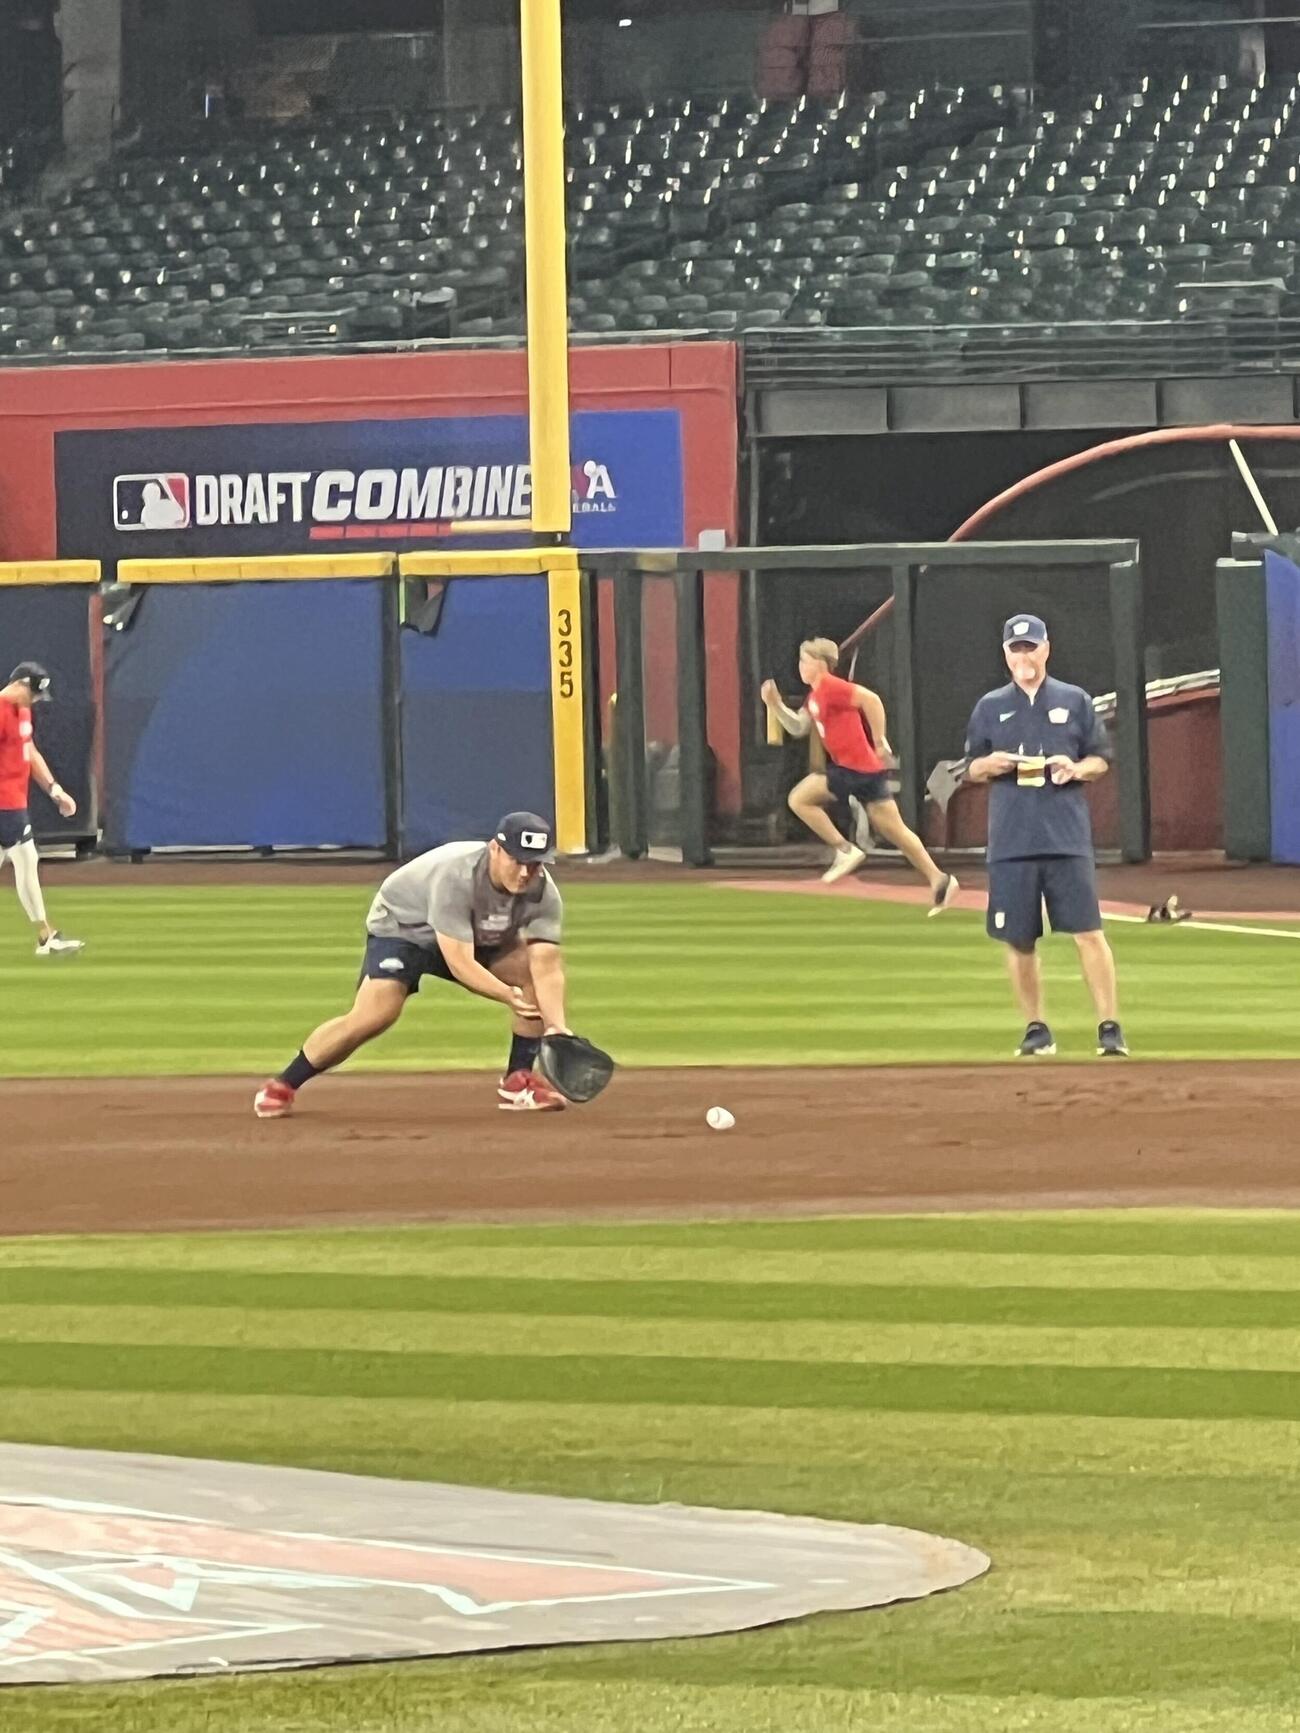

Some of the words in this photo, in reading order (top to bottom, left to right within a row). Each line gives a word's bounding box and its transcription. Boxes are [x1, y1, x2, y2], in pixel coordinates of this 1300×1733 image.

[196, 472, 311, 525] DRAFT
[312, 464, 532, 521] COMBINE
[558, 609, 573, 698] 335
